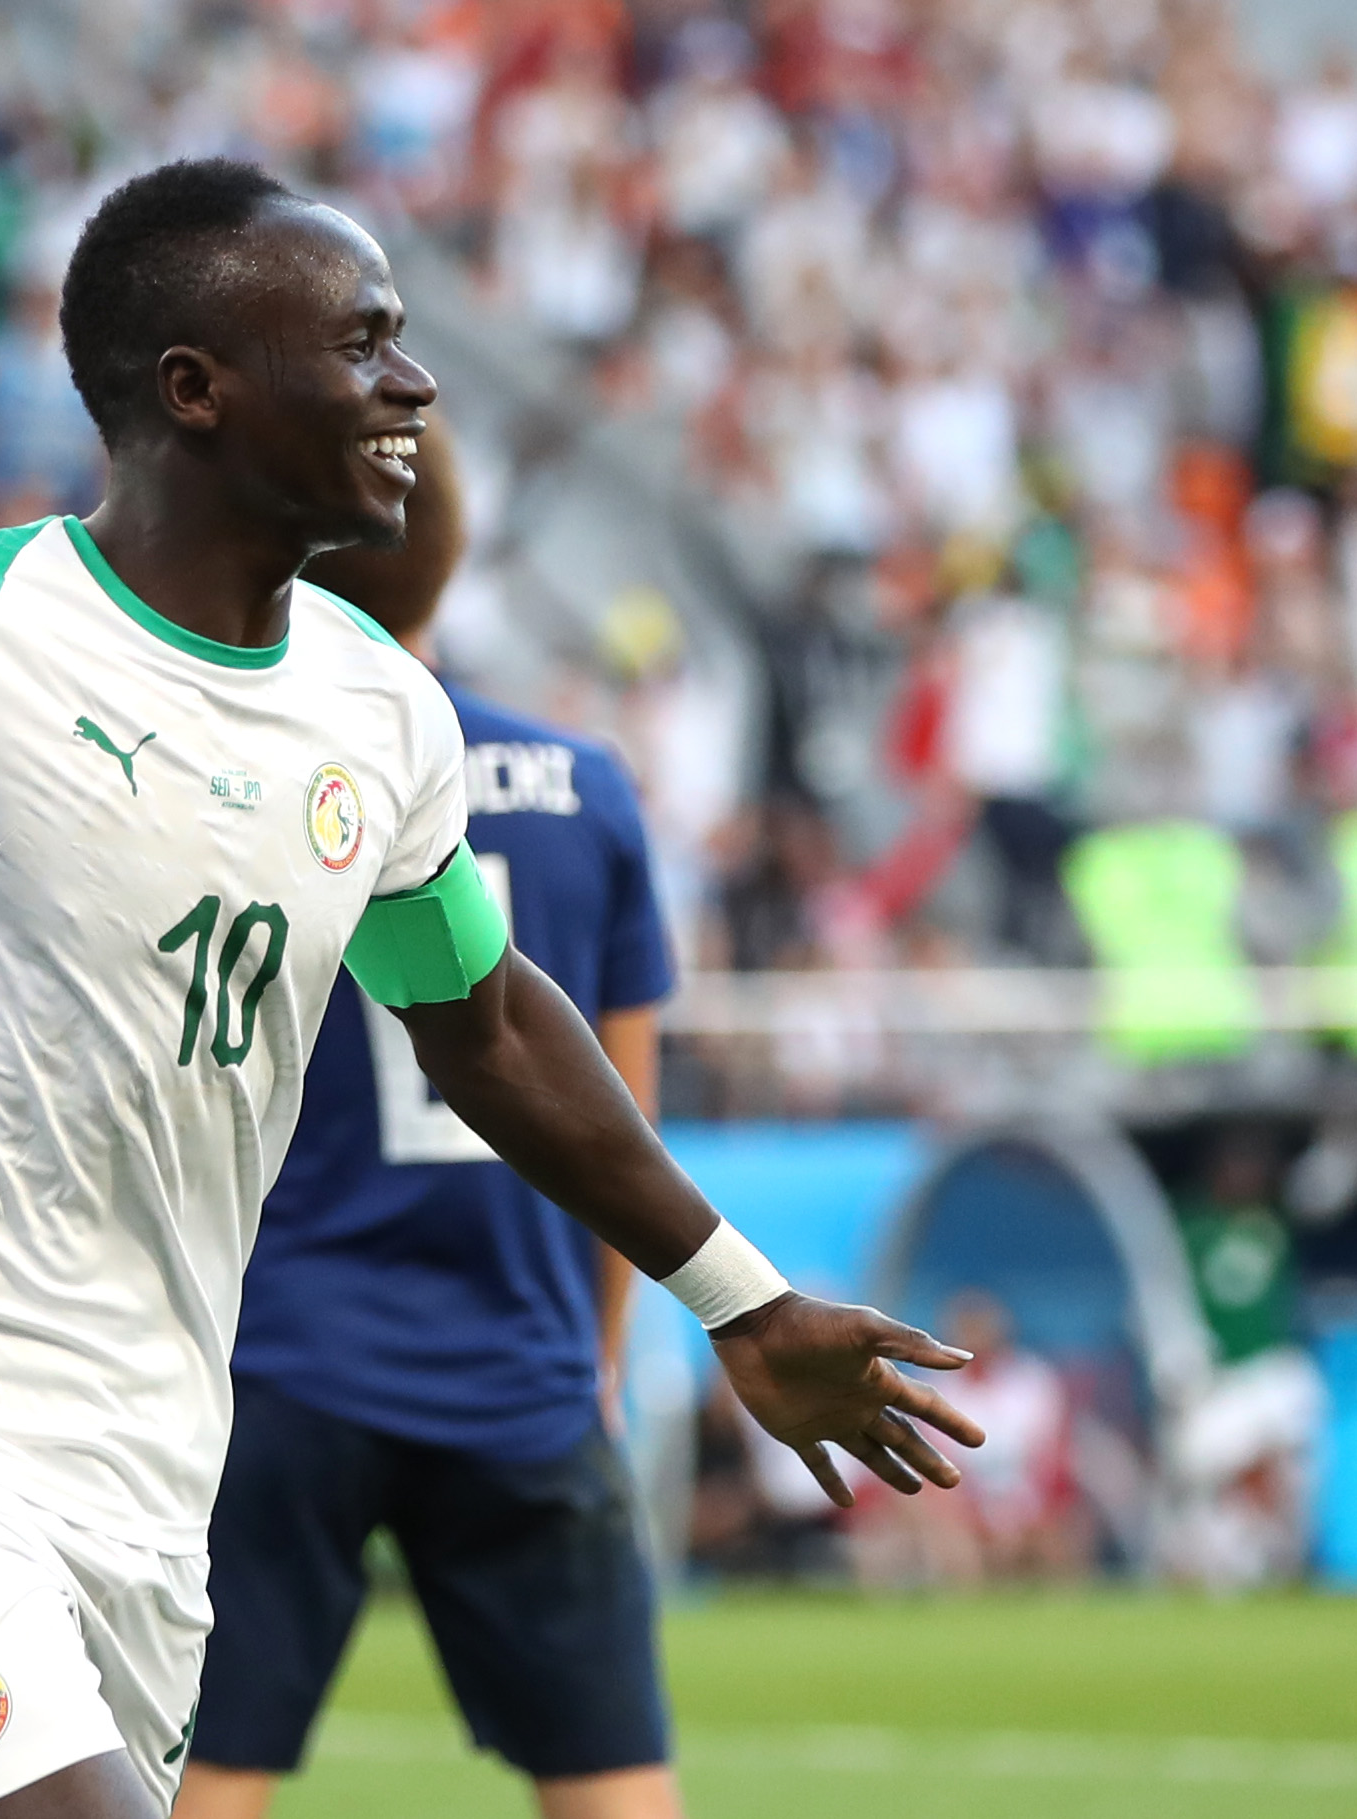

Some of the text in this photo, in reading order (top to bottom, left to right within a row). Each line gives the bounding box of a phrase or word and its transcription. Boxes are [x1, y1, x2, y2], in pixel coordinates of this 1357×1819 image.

[210, 776, 230, 797] SEN
[243, 780, 262, 801] JPN
[158, 895, 289, 1068] 10
